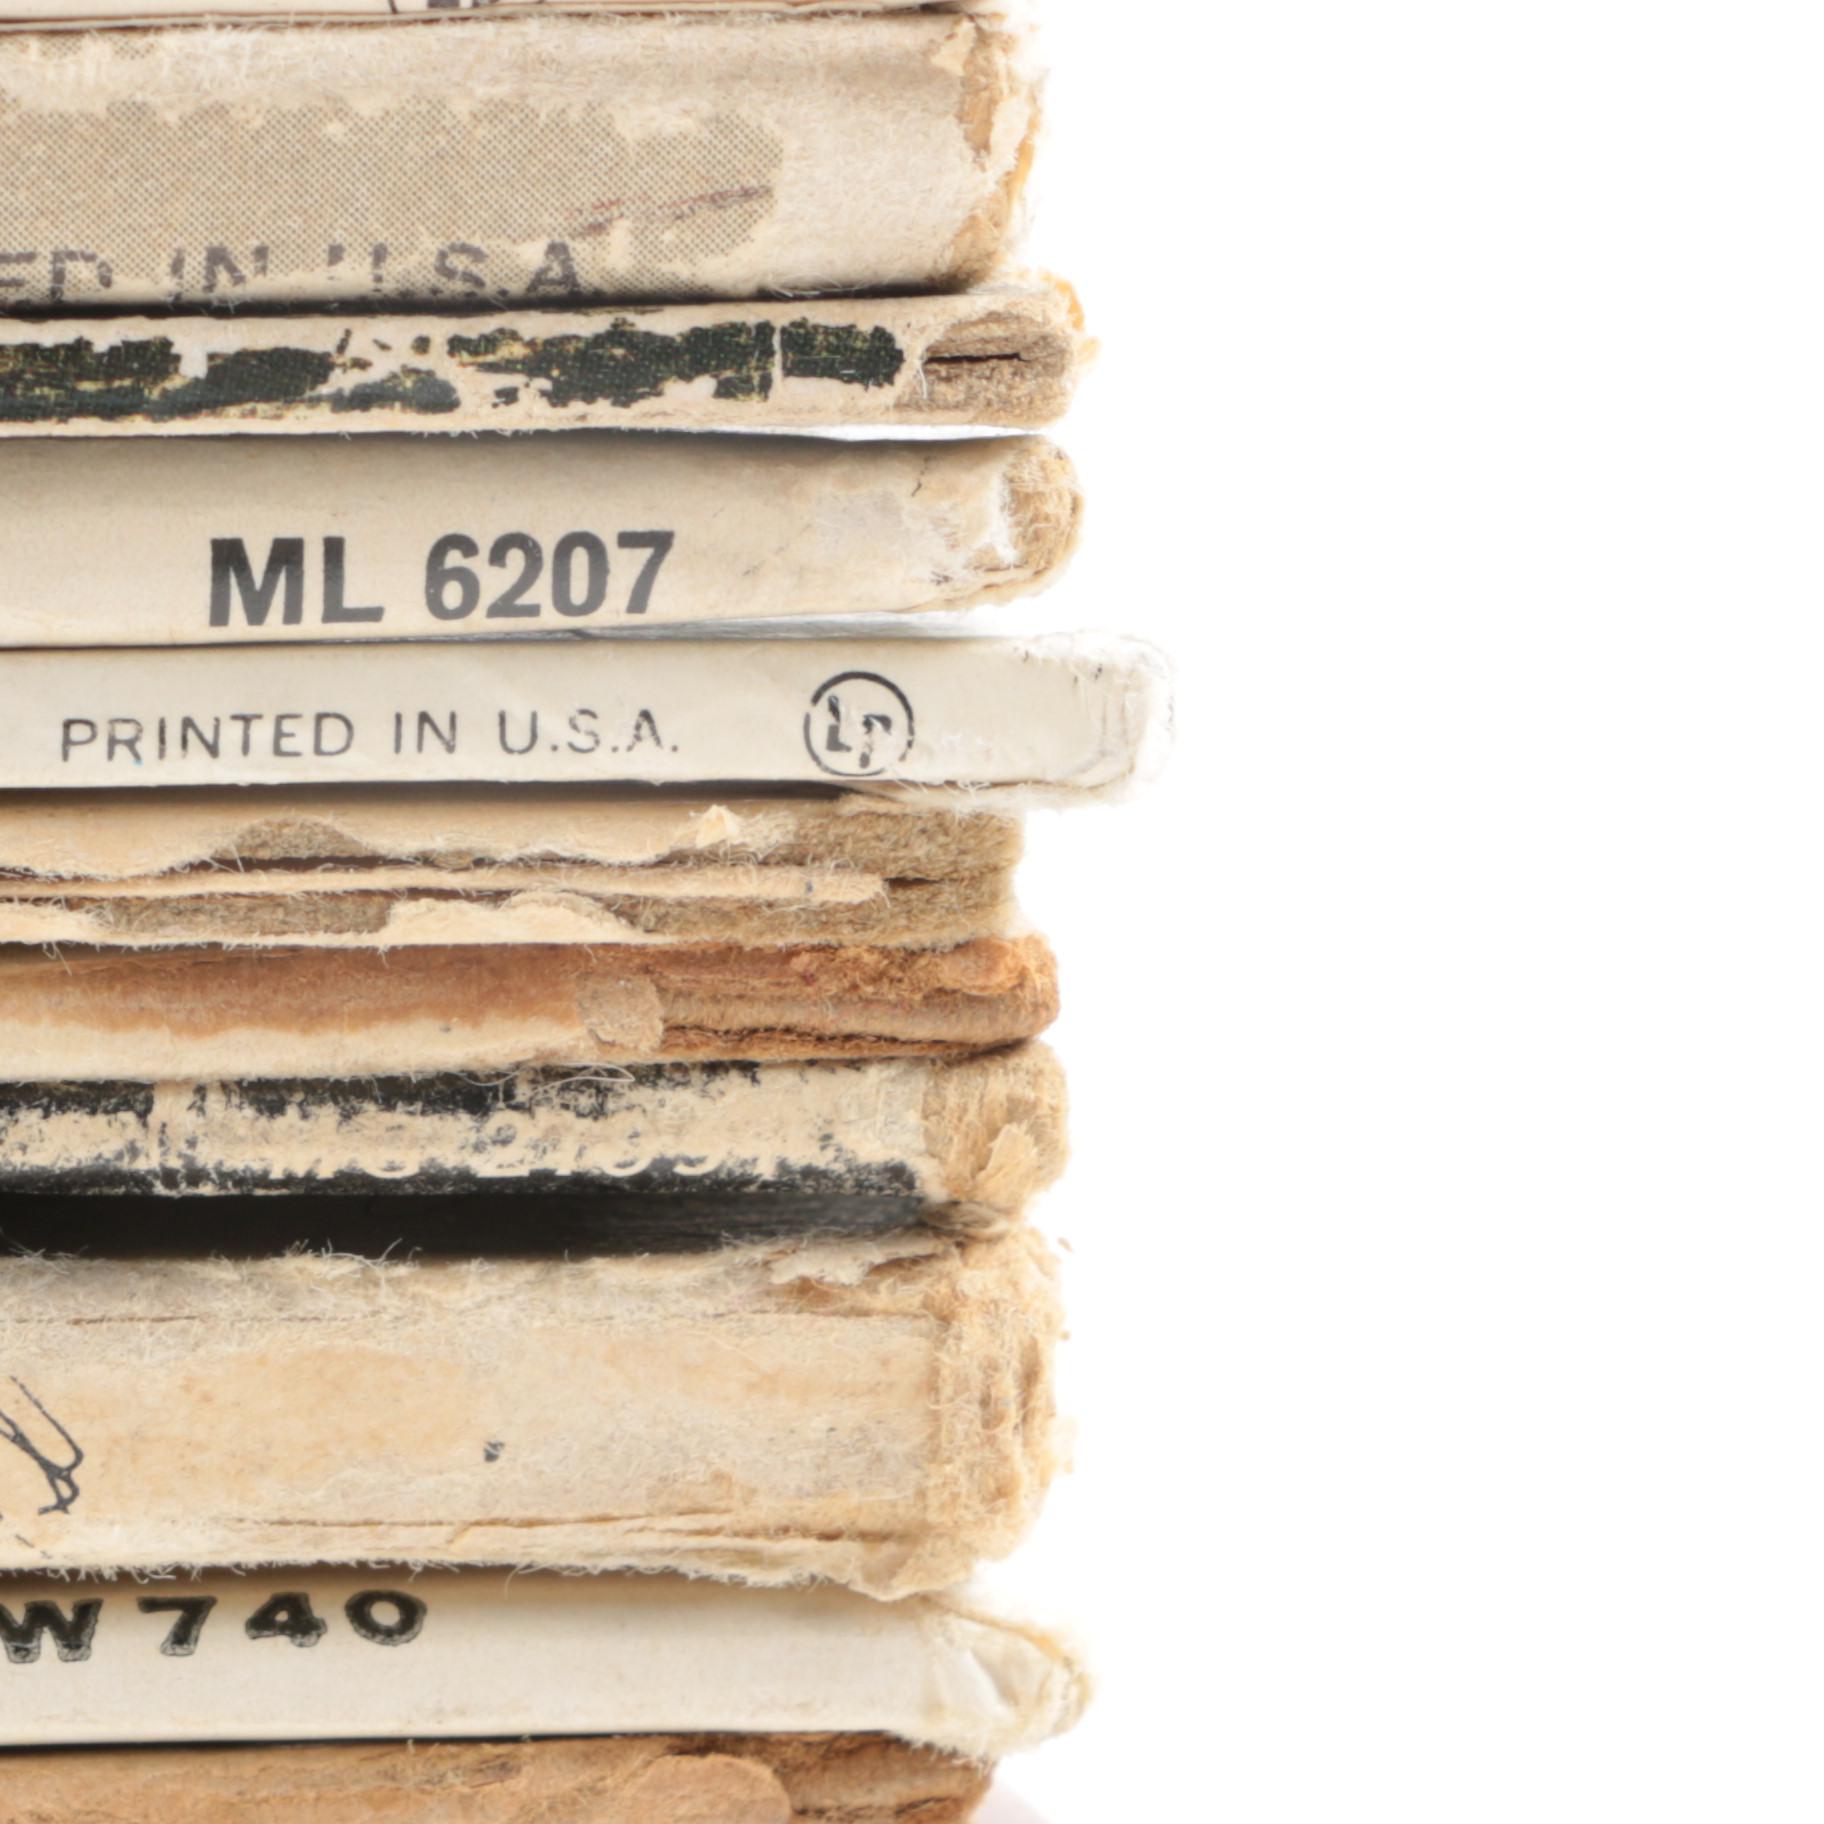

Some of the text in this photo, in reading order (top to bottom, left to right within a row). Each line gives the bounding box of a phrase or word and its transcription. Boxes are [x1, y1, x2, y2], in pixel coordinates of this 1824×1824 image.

[209, 529, 677, 627] ML 6207
[61, 709, 680, 763] PRINTED IN U.S.A.
